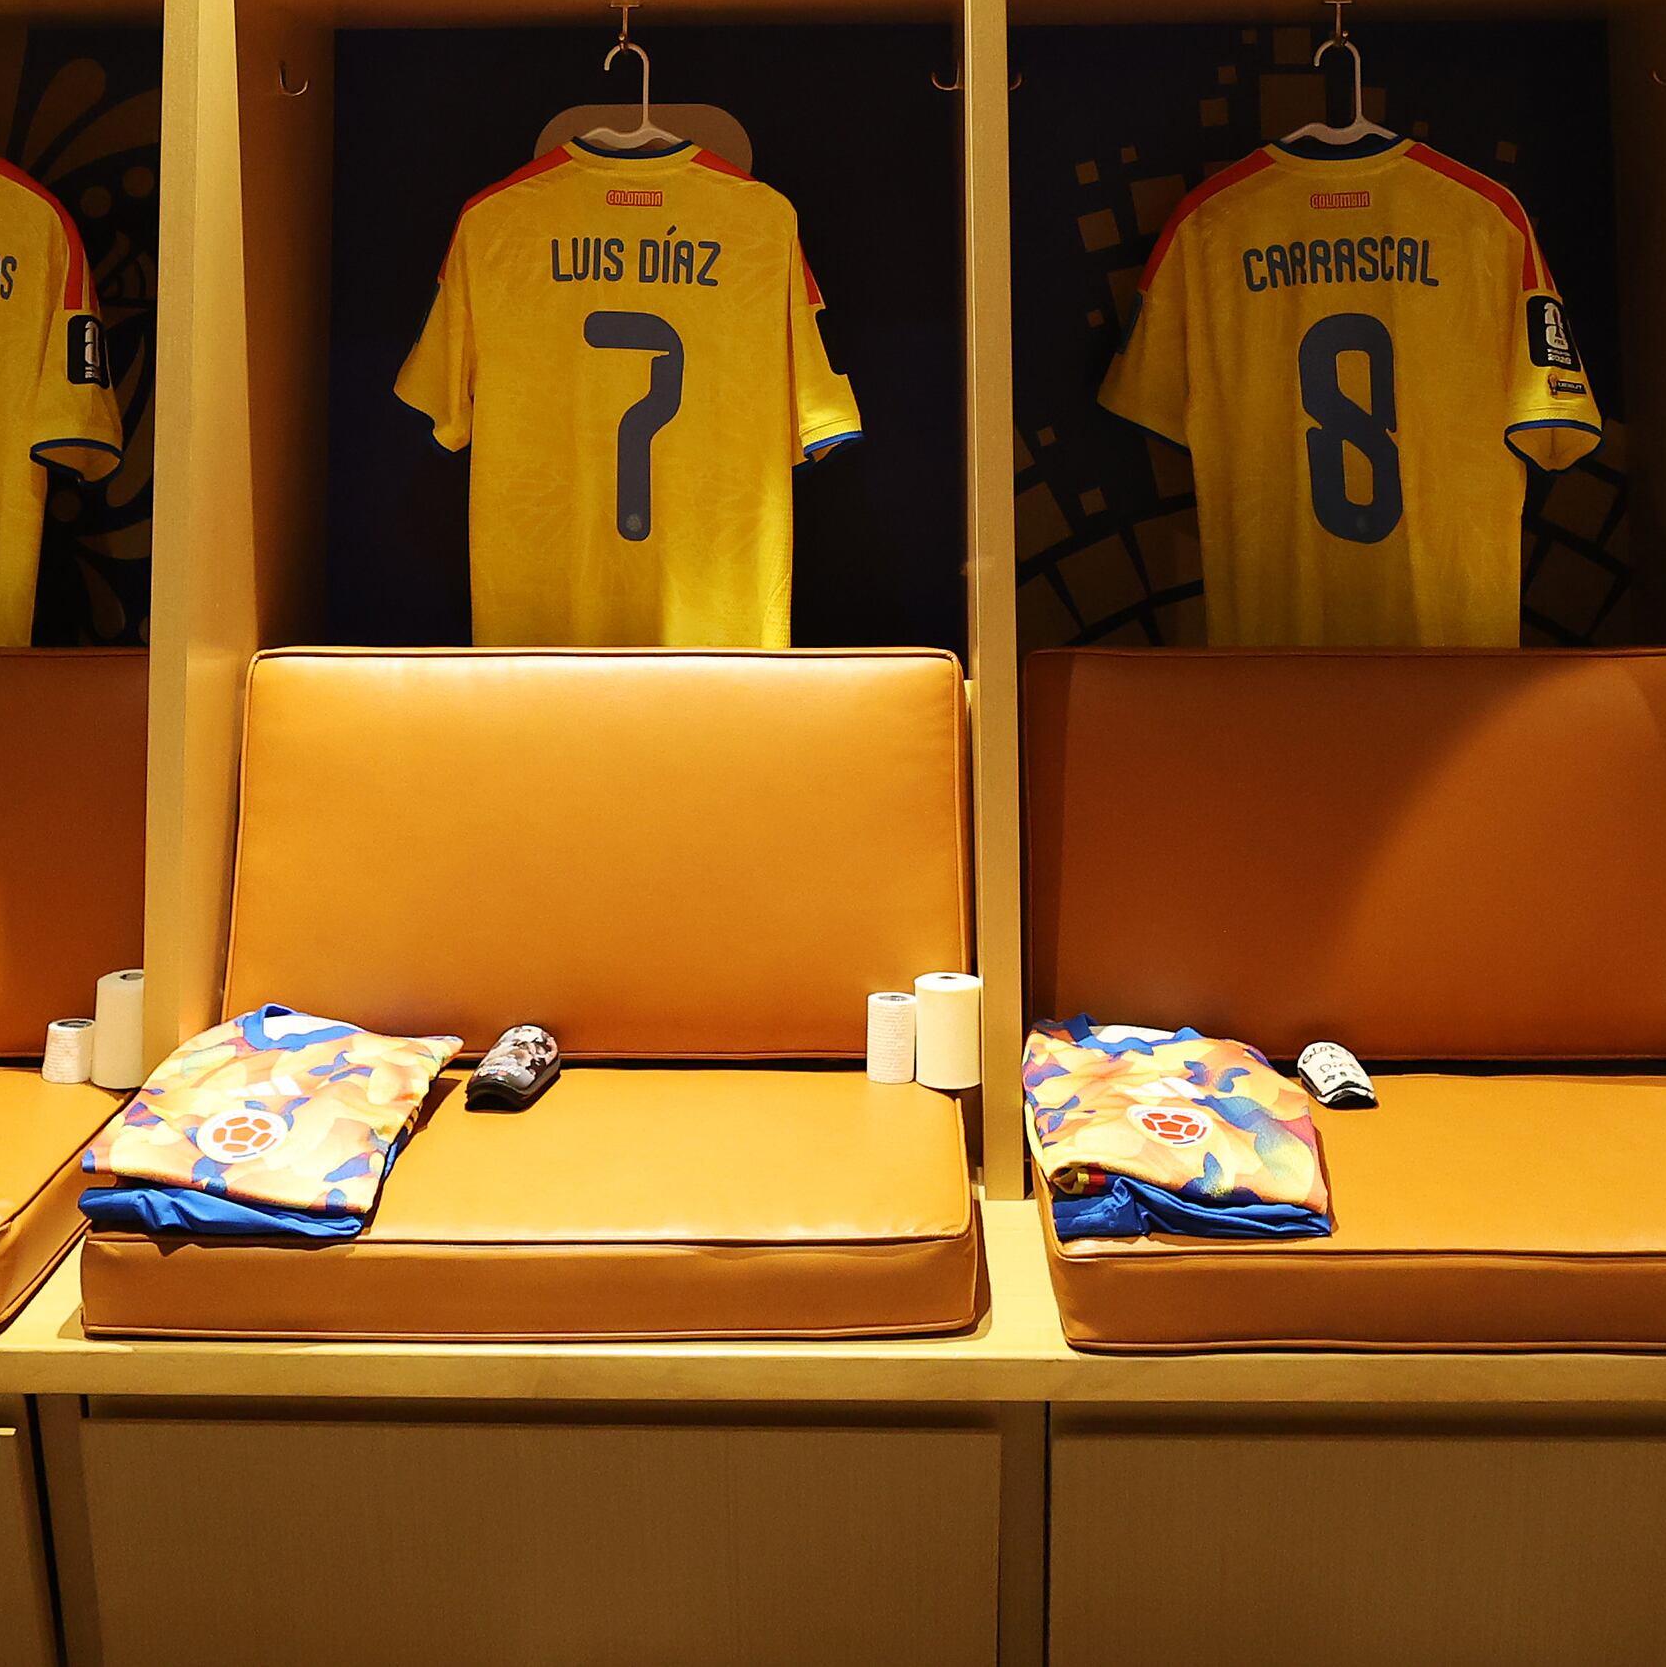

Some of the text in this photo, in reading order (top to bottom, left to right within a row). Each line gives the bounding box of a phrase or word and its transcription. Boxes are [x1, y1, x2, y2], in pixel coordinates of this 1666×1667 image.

[607, 190, 663, 207] COLOMBIA
[1311, 192, 1370, 209] COLOMBIA
[551, 225, 722, 287] LUIS DÍAZ
[1242, 235, 1440, 293] CARRASCAL
[583, 310, 685, 542] 7
[1298, 312, 1404, 545] 8
